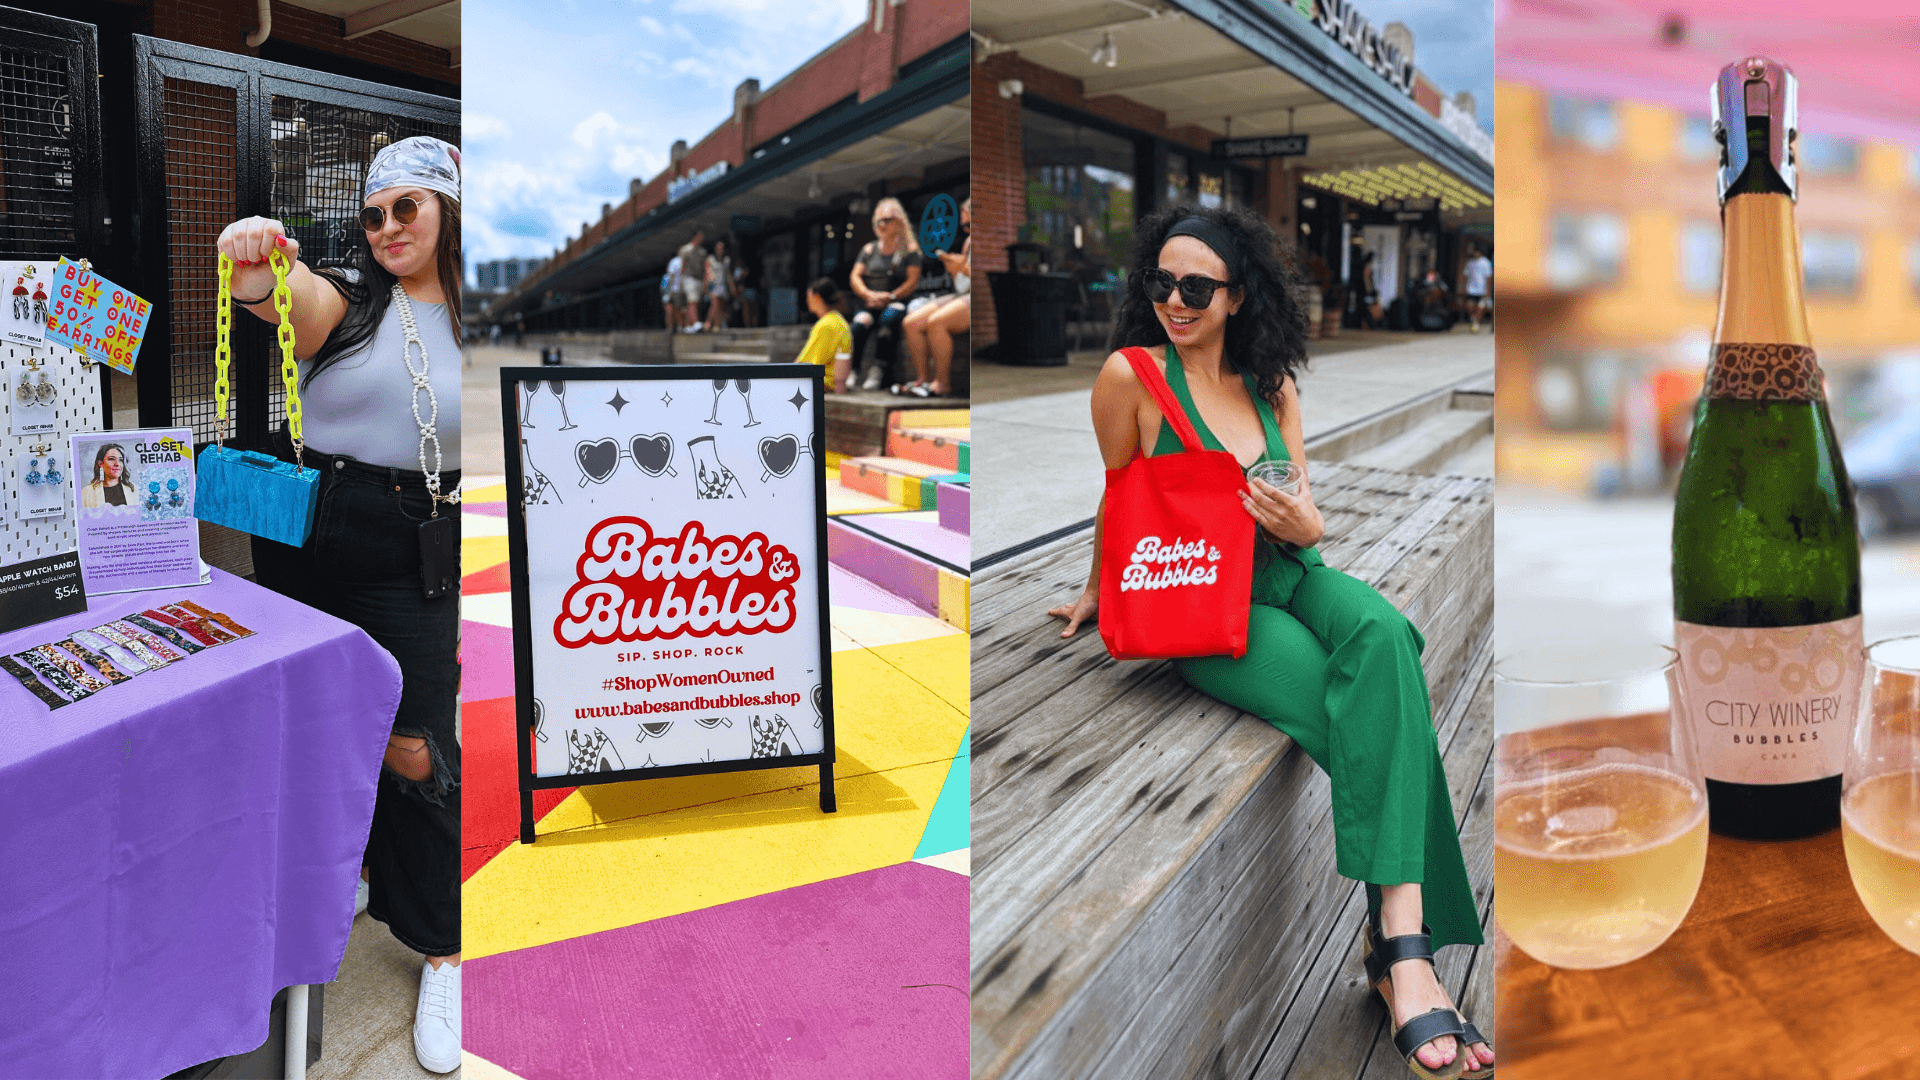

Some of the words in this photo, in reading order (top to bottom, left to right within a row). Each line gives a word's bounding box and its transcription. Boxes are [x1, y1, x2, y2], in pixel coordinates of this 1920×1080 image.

[64, 264, 103, 294] BUY
[112, 290, 146, 318] ONE
[60, 284, 96, 310] GET
[107, 306, 141, 333] ONE
[54, 300, 95, 329] 50%
[104, 325, 137, 348] OFF
[47, 316, 134, 365] EARRINGS
[134, 440, 185, 454] CLOSET
[140, 452, 182, 464] REHAB
[583, 523, 764, 582] Babes
[768, 551, 794, 582] &
[1130, 536, 1206, 564] Babes
[1207, 546, 1221, 562] &
[0, 572, 22, 584] APPLE
[23, 566, 52, 578] WATCH
[54, 560, 77, 571] BANDS
[1120, 559, 1218, 592] Bubbles
[54, 584, 79, 600] $54
[560, 578, 790, 644] Bubbles
[617, 652, 646, 662] SIP.
[652, 648, 698, 660] SHOP.
[704, 646, 744, 657] ROCK
[601, 666, 775, 692] #ShopWomenOwned
[574, 690, 801, 720] www.babesandbubbles.shop
[1705, 700, 1761, 728] CITY
[1769, 694, 1842, 728] WINERY
[1733, 731, 1818, 744] BUBBLES
[1761, 752, 1797, 761] CAVA
